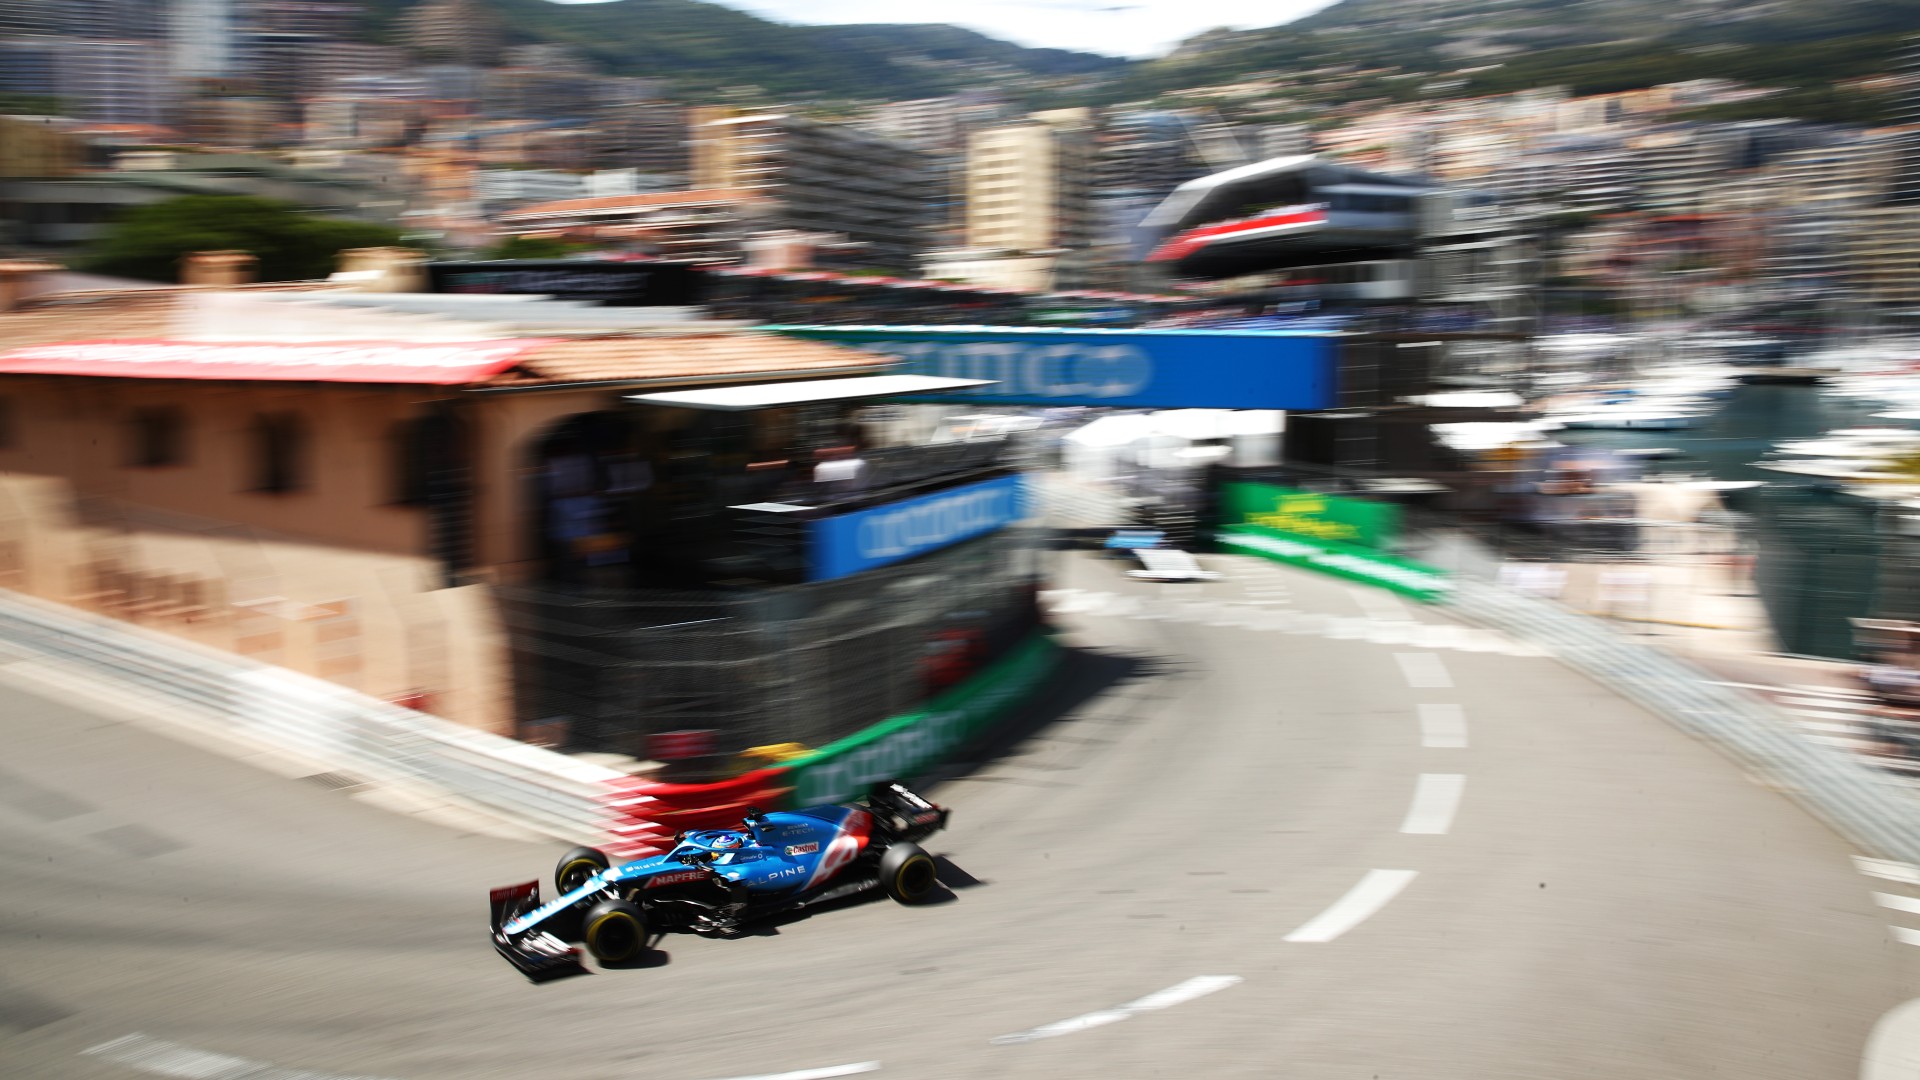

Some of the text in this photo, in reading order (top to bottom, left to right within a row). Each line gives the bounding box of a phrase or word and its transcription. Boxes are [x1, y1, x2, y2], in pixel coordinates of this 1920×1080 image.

[793, 842, 817, 854] Castrol
[655, 871, 705, 885] MAPFRE
[746, 864, 806, 888] ALPINE
